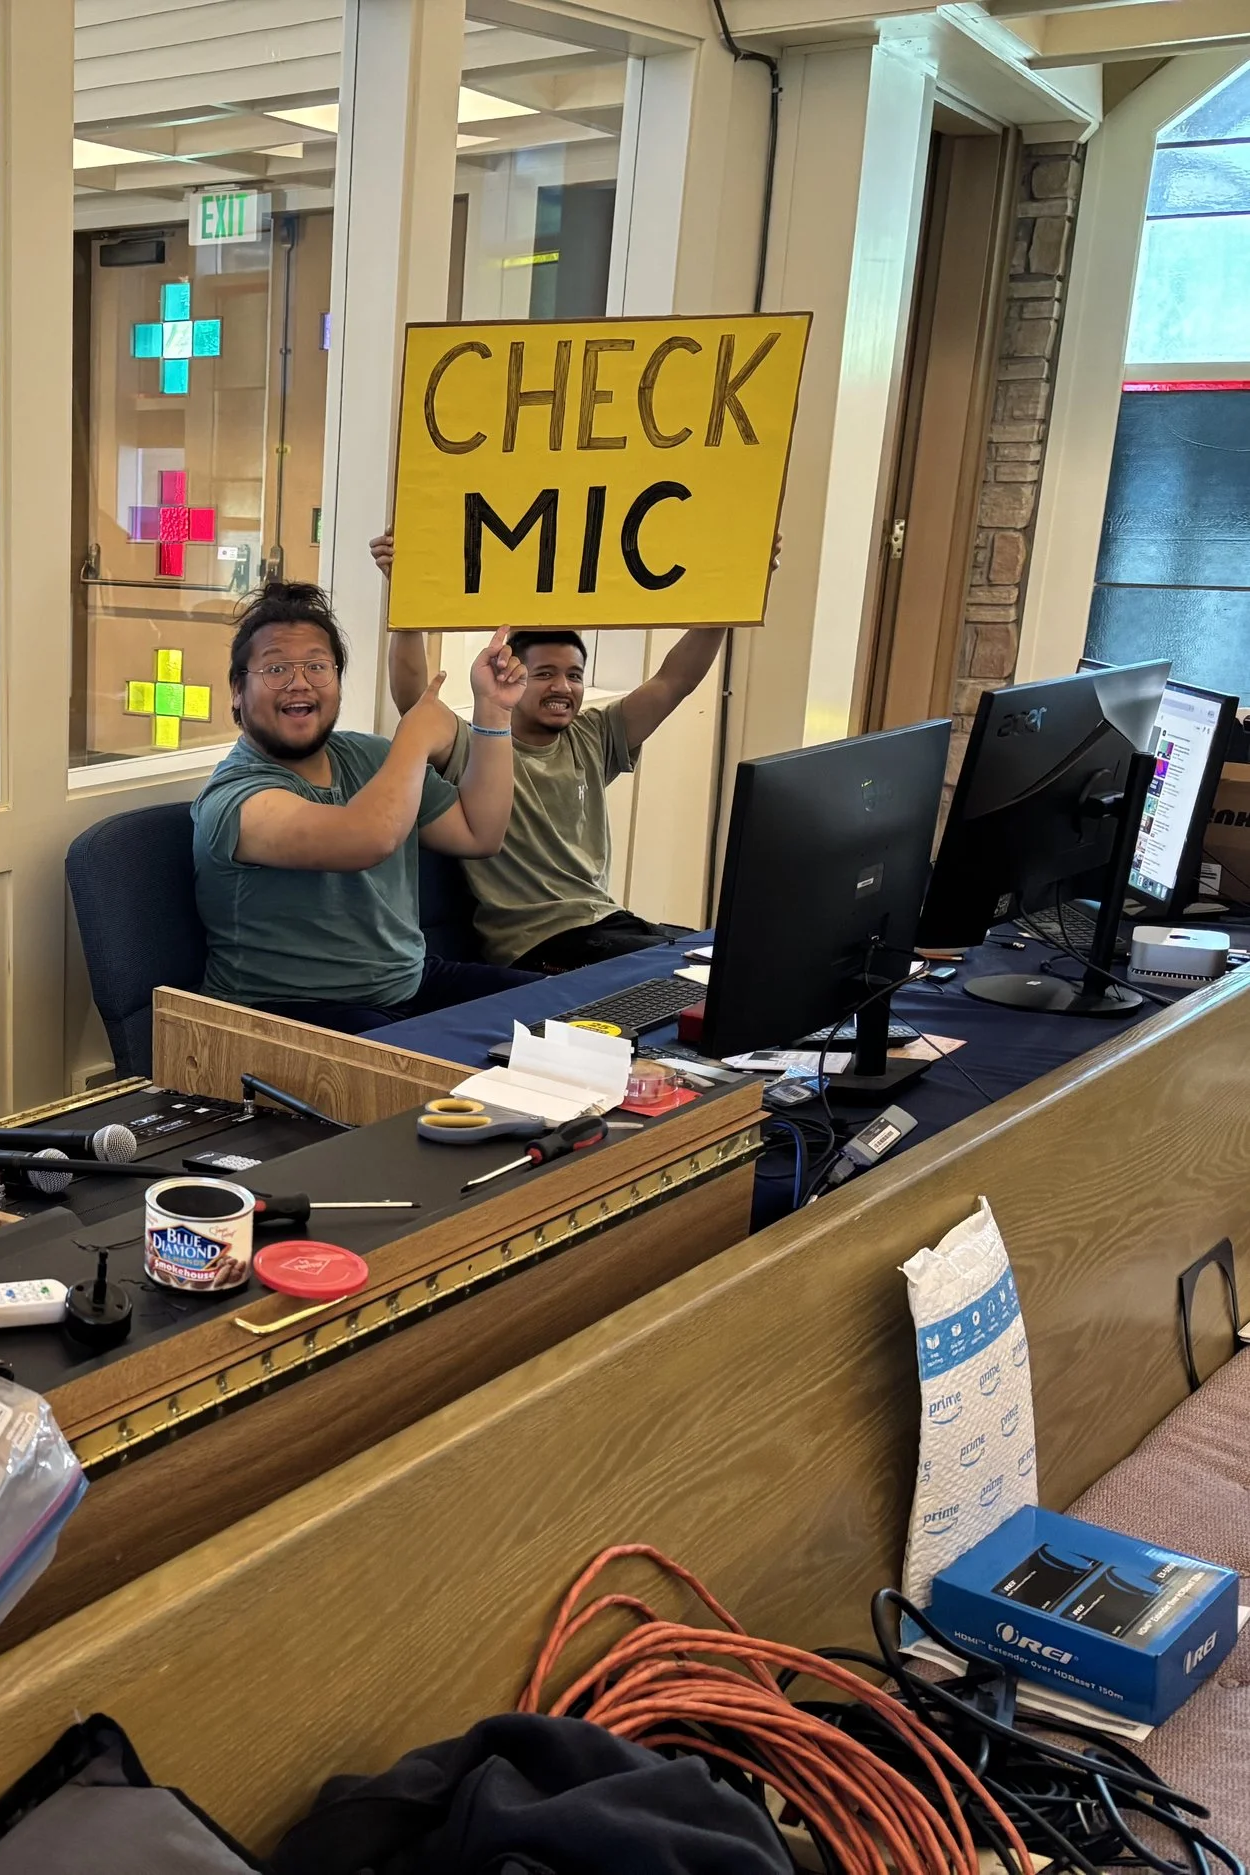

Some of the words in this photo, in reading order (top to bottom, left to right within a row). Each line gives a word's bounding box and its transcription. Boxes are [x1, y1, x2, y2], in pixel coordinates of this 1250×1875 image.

[202, 192, 248, 239] EXIT
[424, 332, 781, 456] CHECK
[464, 480, 692, 594] MIC
[153, 1232, 220, 1260] DIAMOND
[166, 1227, 203, 1248] BLUE
[154, 1259, 217, 1280] Smokehouse
[929, 1391, 961, 1418] prime
[960, 1433, 985, 1459] prime
[923, 1503, 959, 1528] prime
[988, 1643, 1029, 1664] Extender
[1030, 1660, 1052, 1673] Over
[1053, 1669, 1096, 1690] HDBaseT
[1099, 1685, 1124, 1701] 150m
